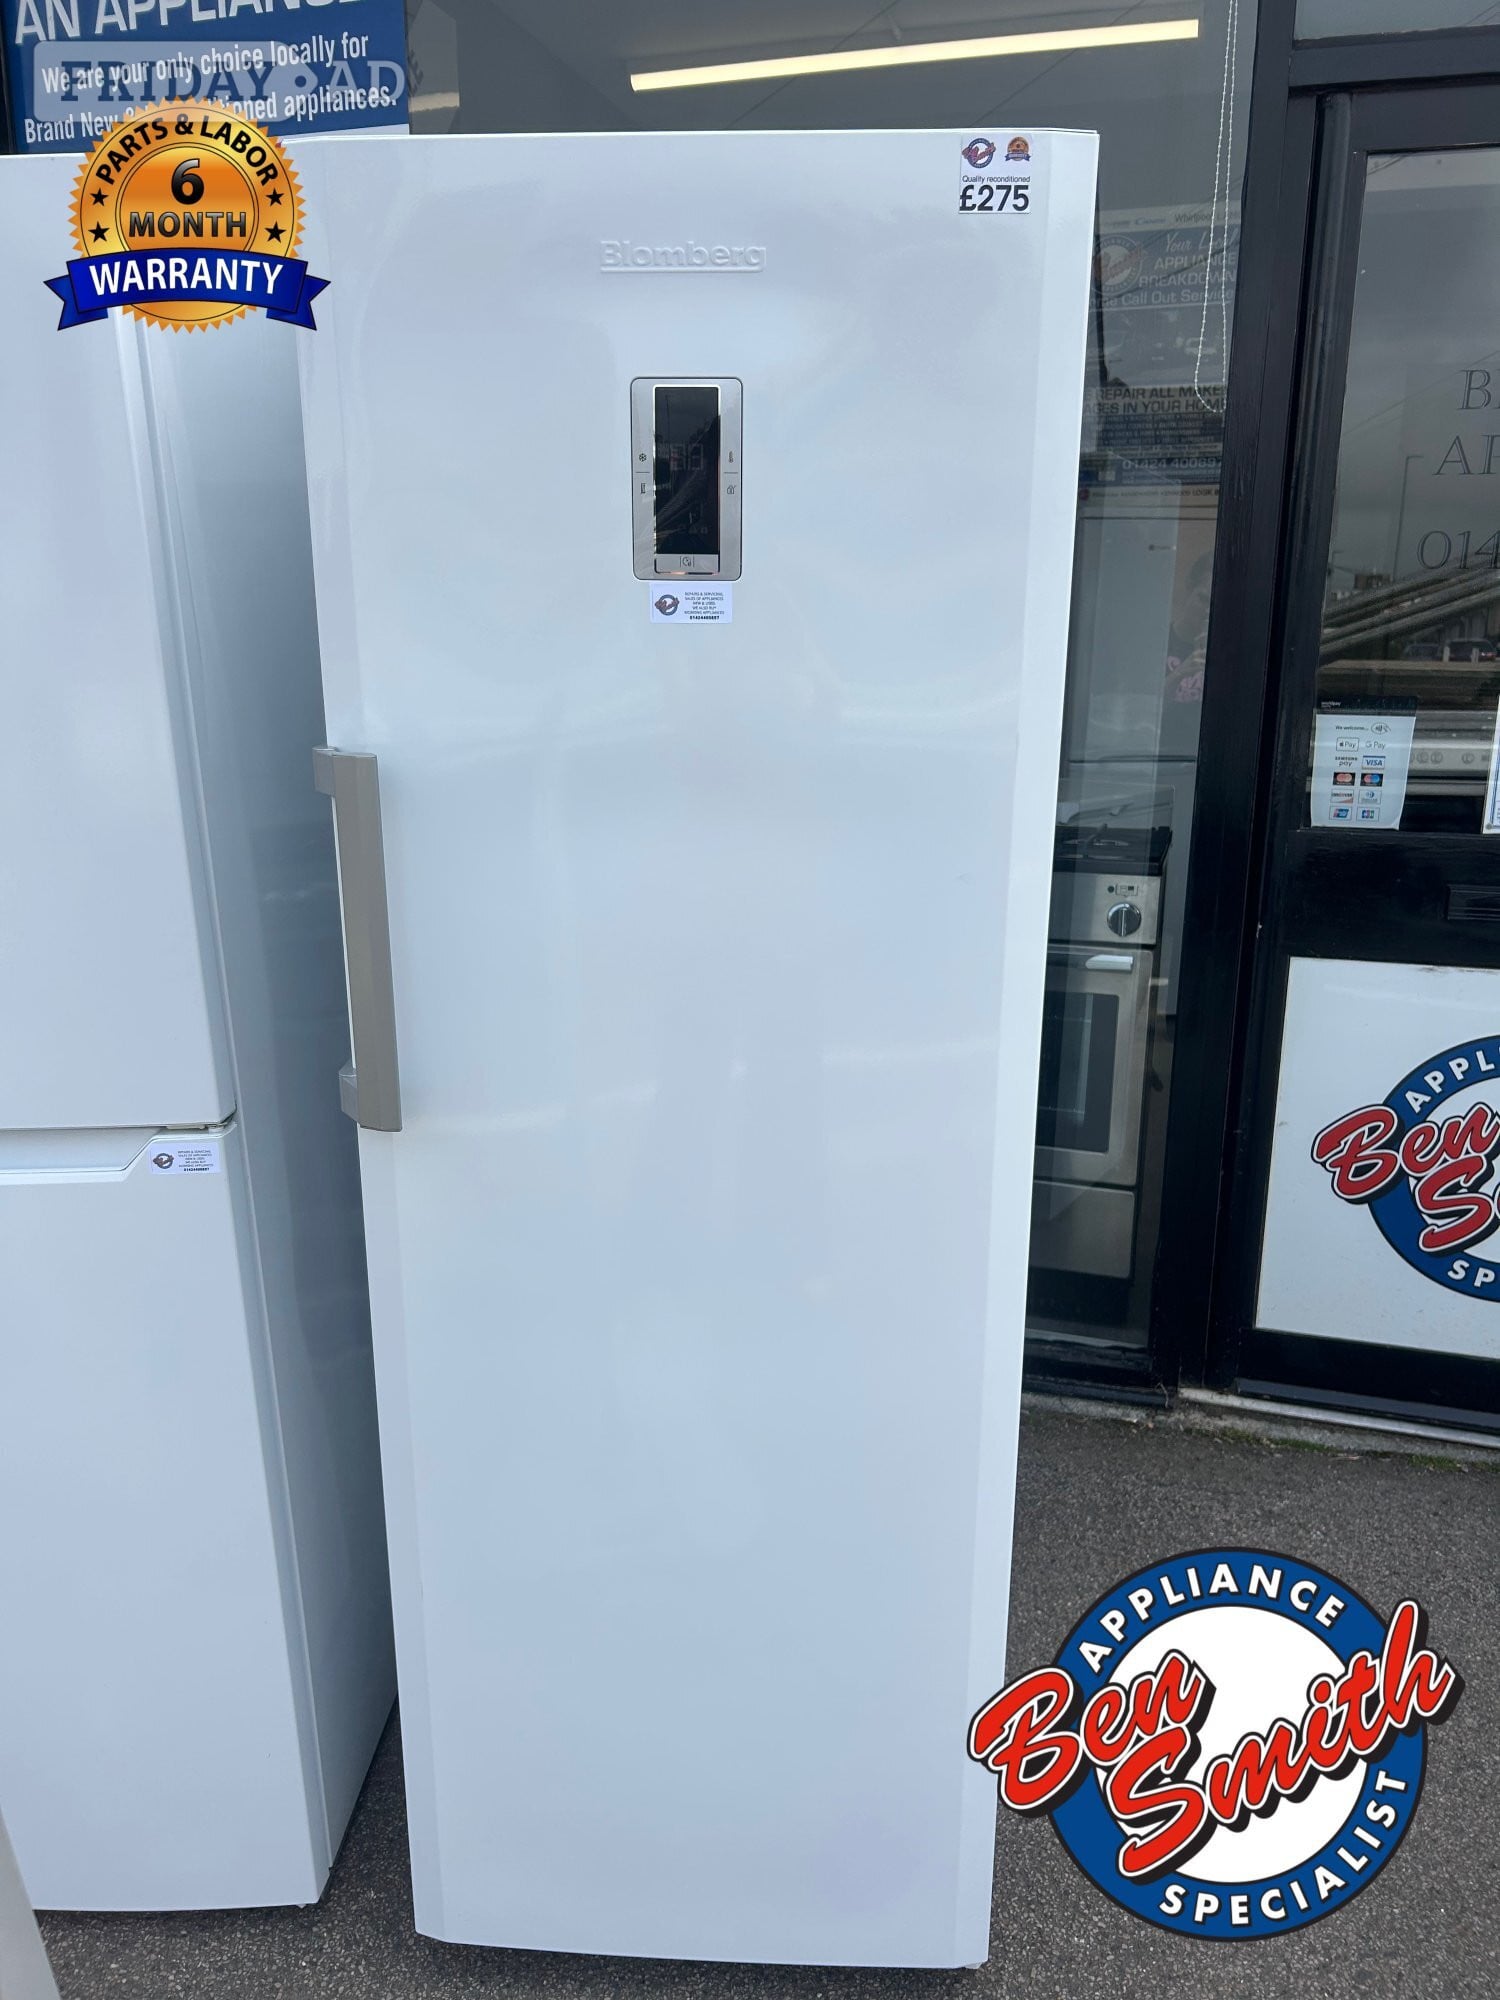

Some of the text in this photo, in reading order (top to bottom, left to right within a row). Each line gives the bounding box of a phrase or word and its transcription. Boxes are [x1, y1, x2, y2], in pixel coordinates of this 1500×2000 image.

[15, 0, 362, 44] AN APPLI
[42, 31, 369, 94] We are your only choice locally for
[284, 85, 397, 124] appliances.
[25, 115, 75, 144] Brand
[81, 111, 118, 138] New
[962, 175, 985, 184] Quality
[959, 184, 1030, 212] £275
[1174, 212, 1214, 224] Whirlpoo
[599, 239, 769, 273] Blomberg
[1121, 291, 1148, 306] Call
[1151, 290, 1177, 305] Out
[1149, 386, 1175, 399] ALL
[1178, 384, 1225, 398] MAKE
[1457, 368, 1500, 411] B
[1123, 401, 1138, 414] IN
[1142, 399, 1182, 413] YOUR
[1373, 741, 1386, 750] Pay
[1404, 1043, 1500, 1114] APPL
[1312, 1103, 1500, 1204] Ben
[1413, 1154, 1500, 1258] S
